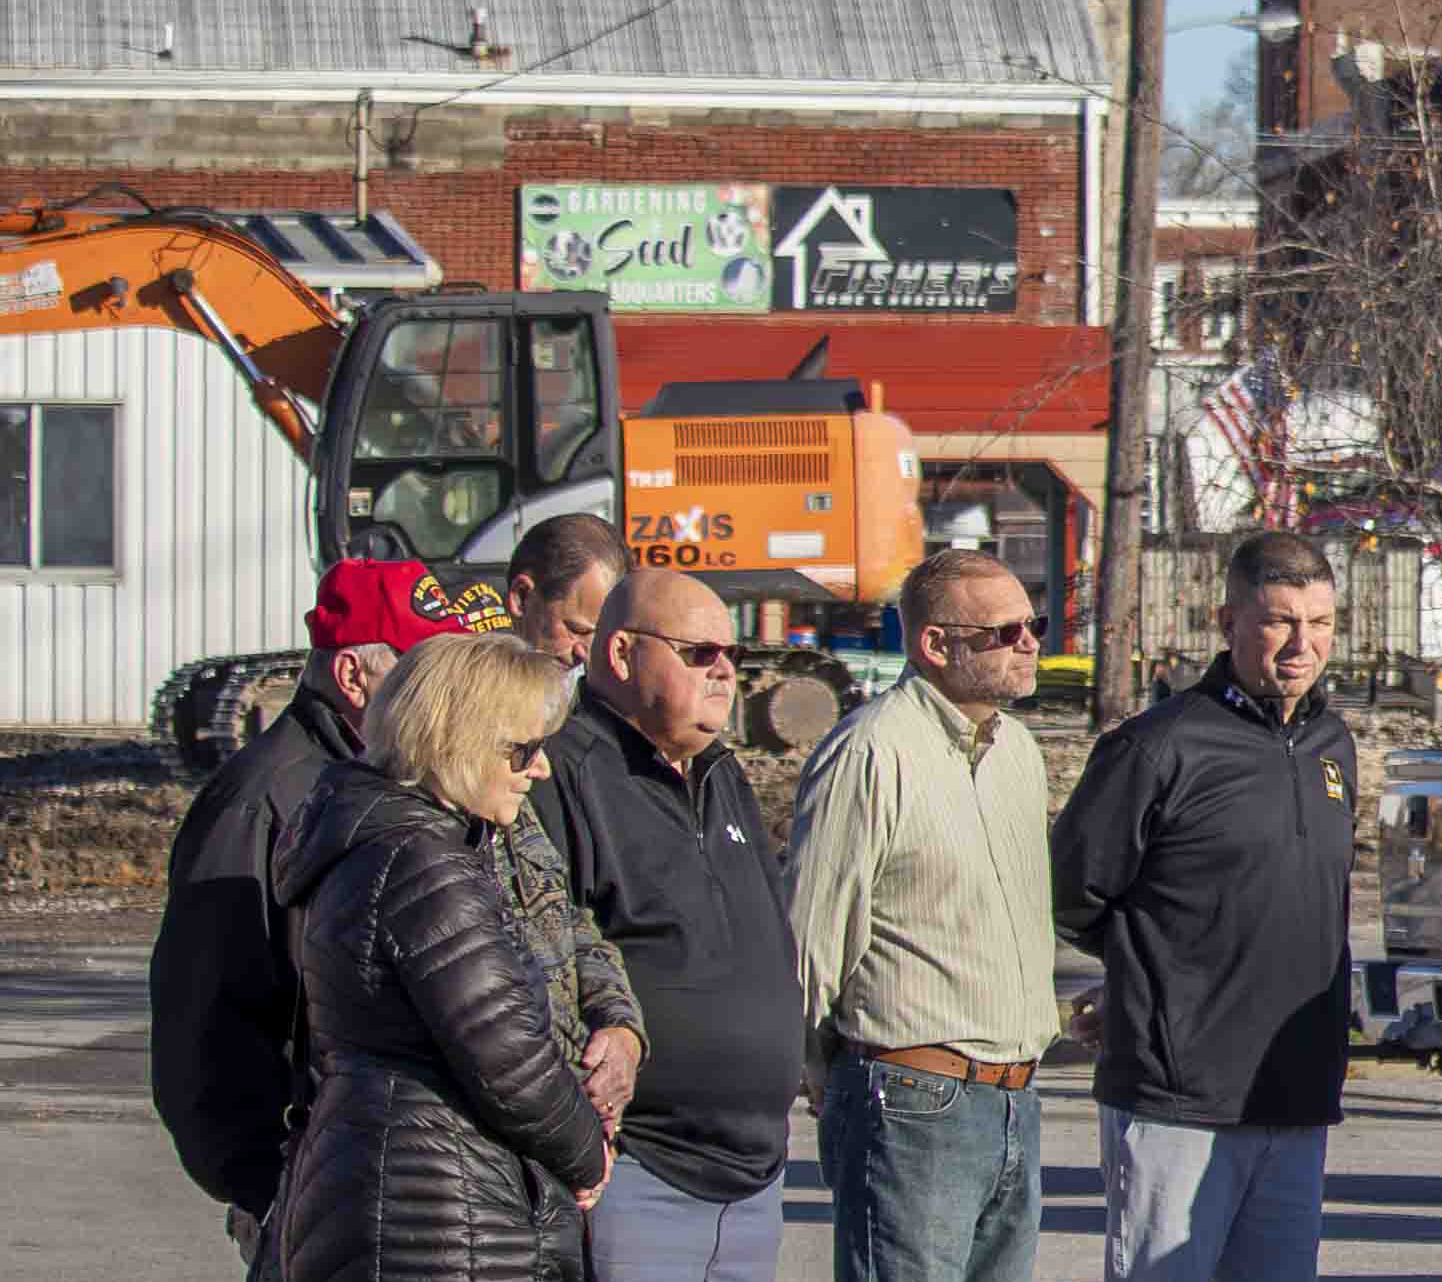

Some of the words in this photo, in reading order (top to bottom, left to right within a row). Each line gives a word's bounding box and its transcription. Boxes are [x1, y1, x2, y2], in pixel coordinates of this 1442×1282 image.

[566, 188, 707, 215] GARDENING
[597, 219, 696, 277] Seed
[811, 243, 1017, 294] FISHER'S
[631, 504, 734, 543] ZAXIS
[631, 543, 701, 568] 160
[704, 552, 737, 567] LC
